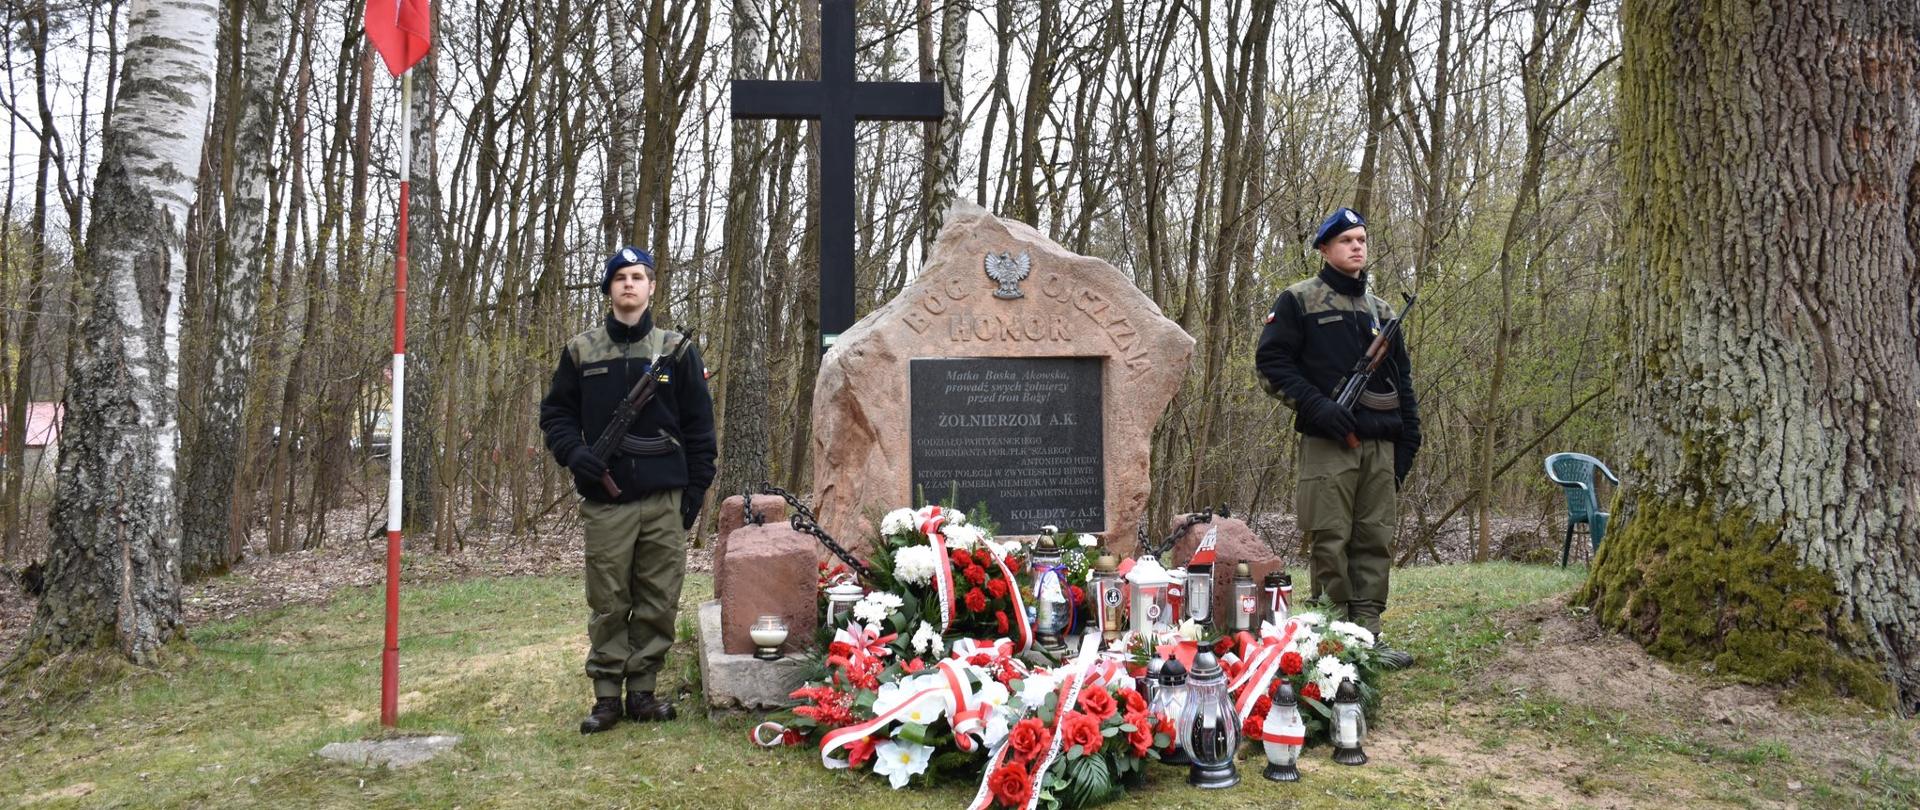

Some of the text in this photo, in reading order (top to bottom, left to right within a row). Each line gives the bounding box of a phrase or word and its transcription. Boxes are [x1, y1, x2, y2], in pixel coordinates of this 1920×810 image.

[950, 313, 1073, 342] HONOR
[1041, 273, 1152, 382] OJCZYZNA
[990, 380, 1022, 394] swych
[967, 392, 996, 405] przed
[998, 393, 1019, 403] tron
[1049, 413, 1078, 427] A.K.
[1030, 488, 1074, 498] KWIETNIA
[1011, 507, 1067, 520] KOLEDZY
